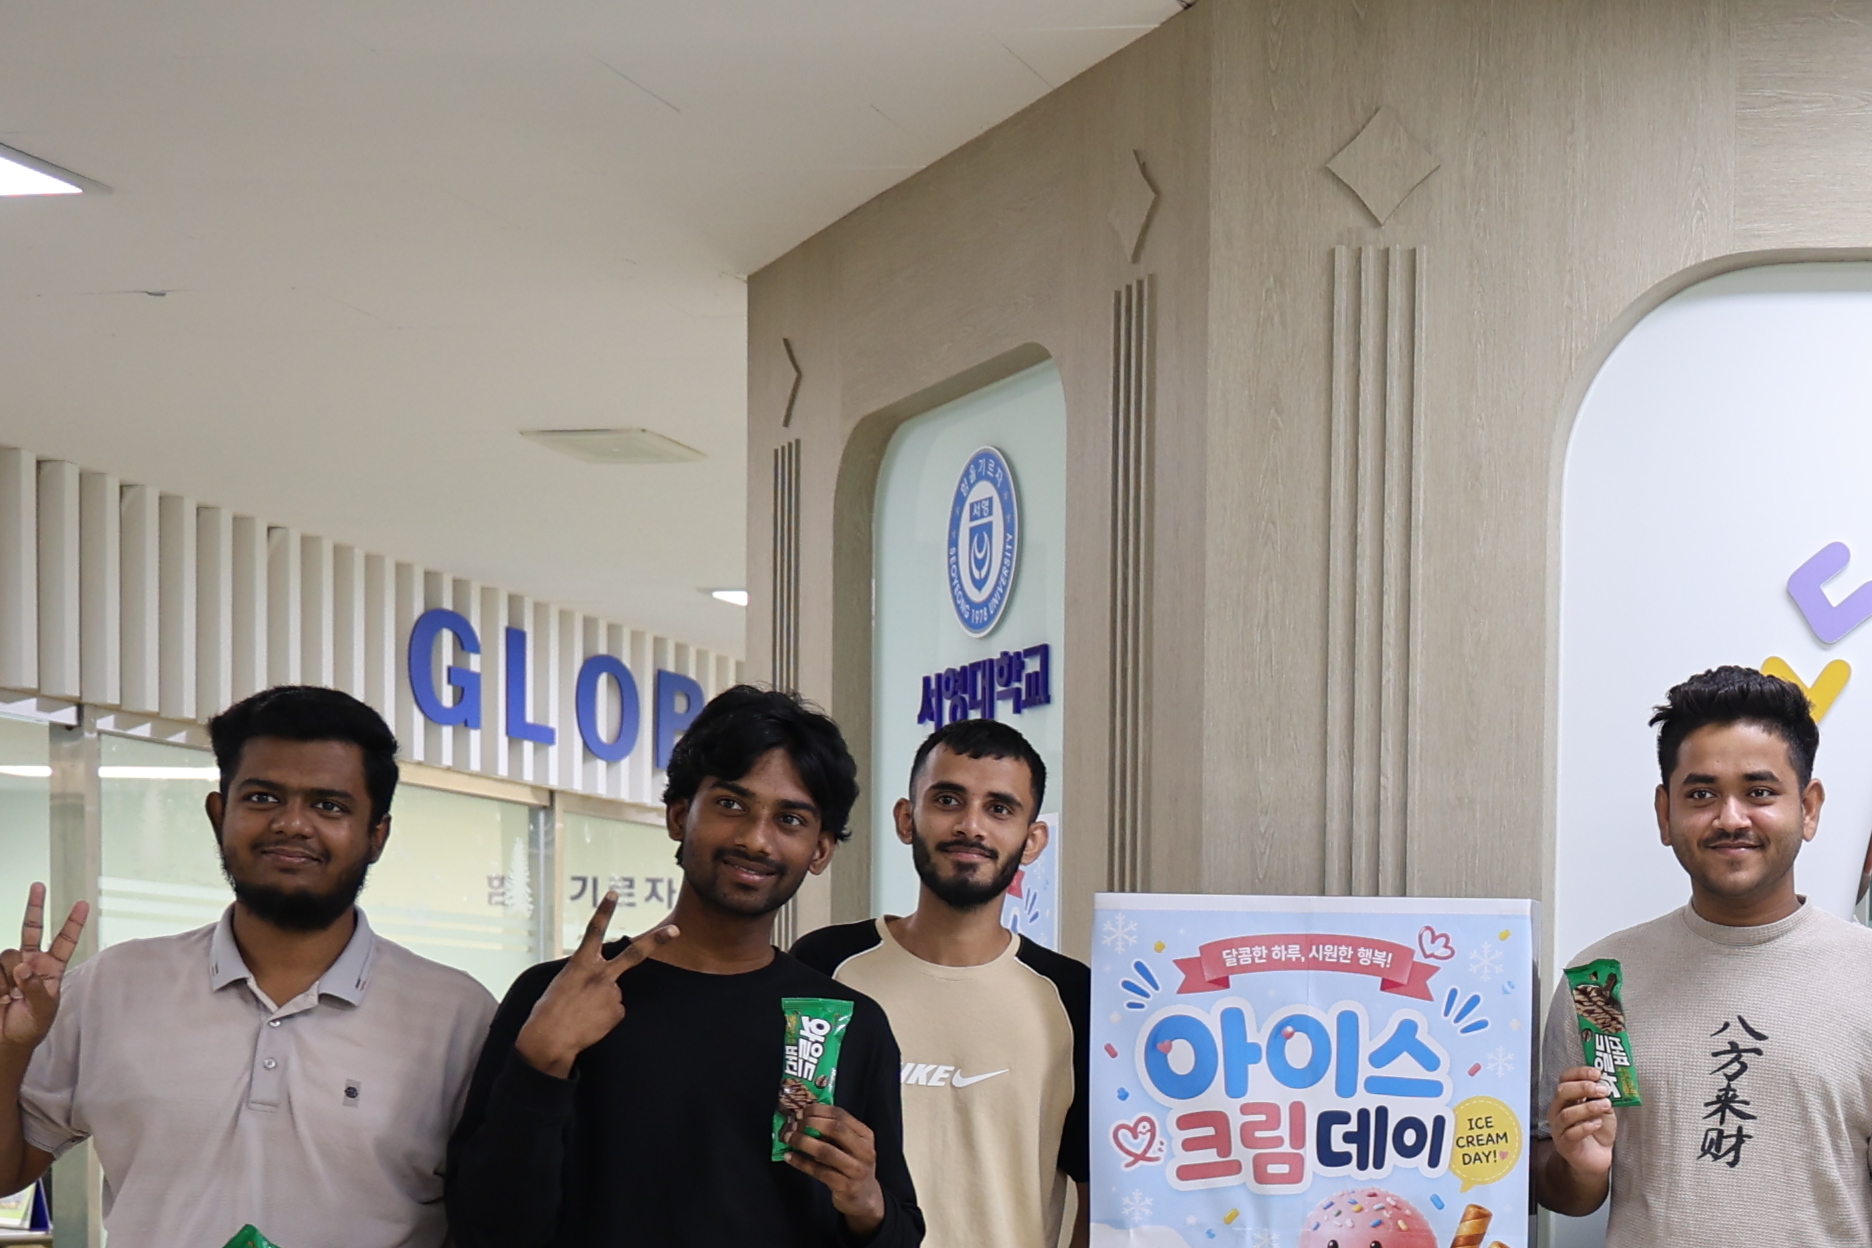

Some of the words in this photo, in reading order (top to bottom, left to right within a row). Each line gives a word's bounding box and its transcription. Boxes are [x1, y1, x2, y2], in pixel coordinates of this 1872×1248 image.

[917, 643, 1051, 732] 서영대학교
[1222, 945, 1267, 967] 달콤한
[1271, 944, 1305, 962] 하루,
[1308, 944, 1353, 964] 시원한
[1357, 946, 1393, 968] 행복!
[1144, 1006, 1444, 1100] 아이스
[901, 1062, 955, 1087] IKE
[1467, 1116, 1494, 1131] ICE
[1175, 1100, 1306, 1185] 크림
[1316, 1105, 1446, 1171] 데이
[1455, 1131, 1509, 1149] CREAM
[1462, 1149, 1497, 1166] DAY!
